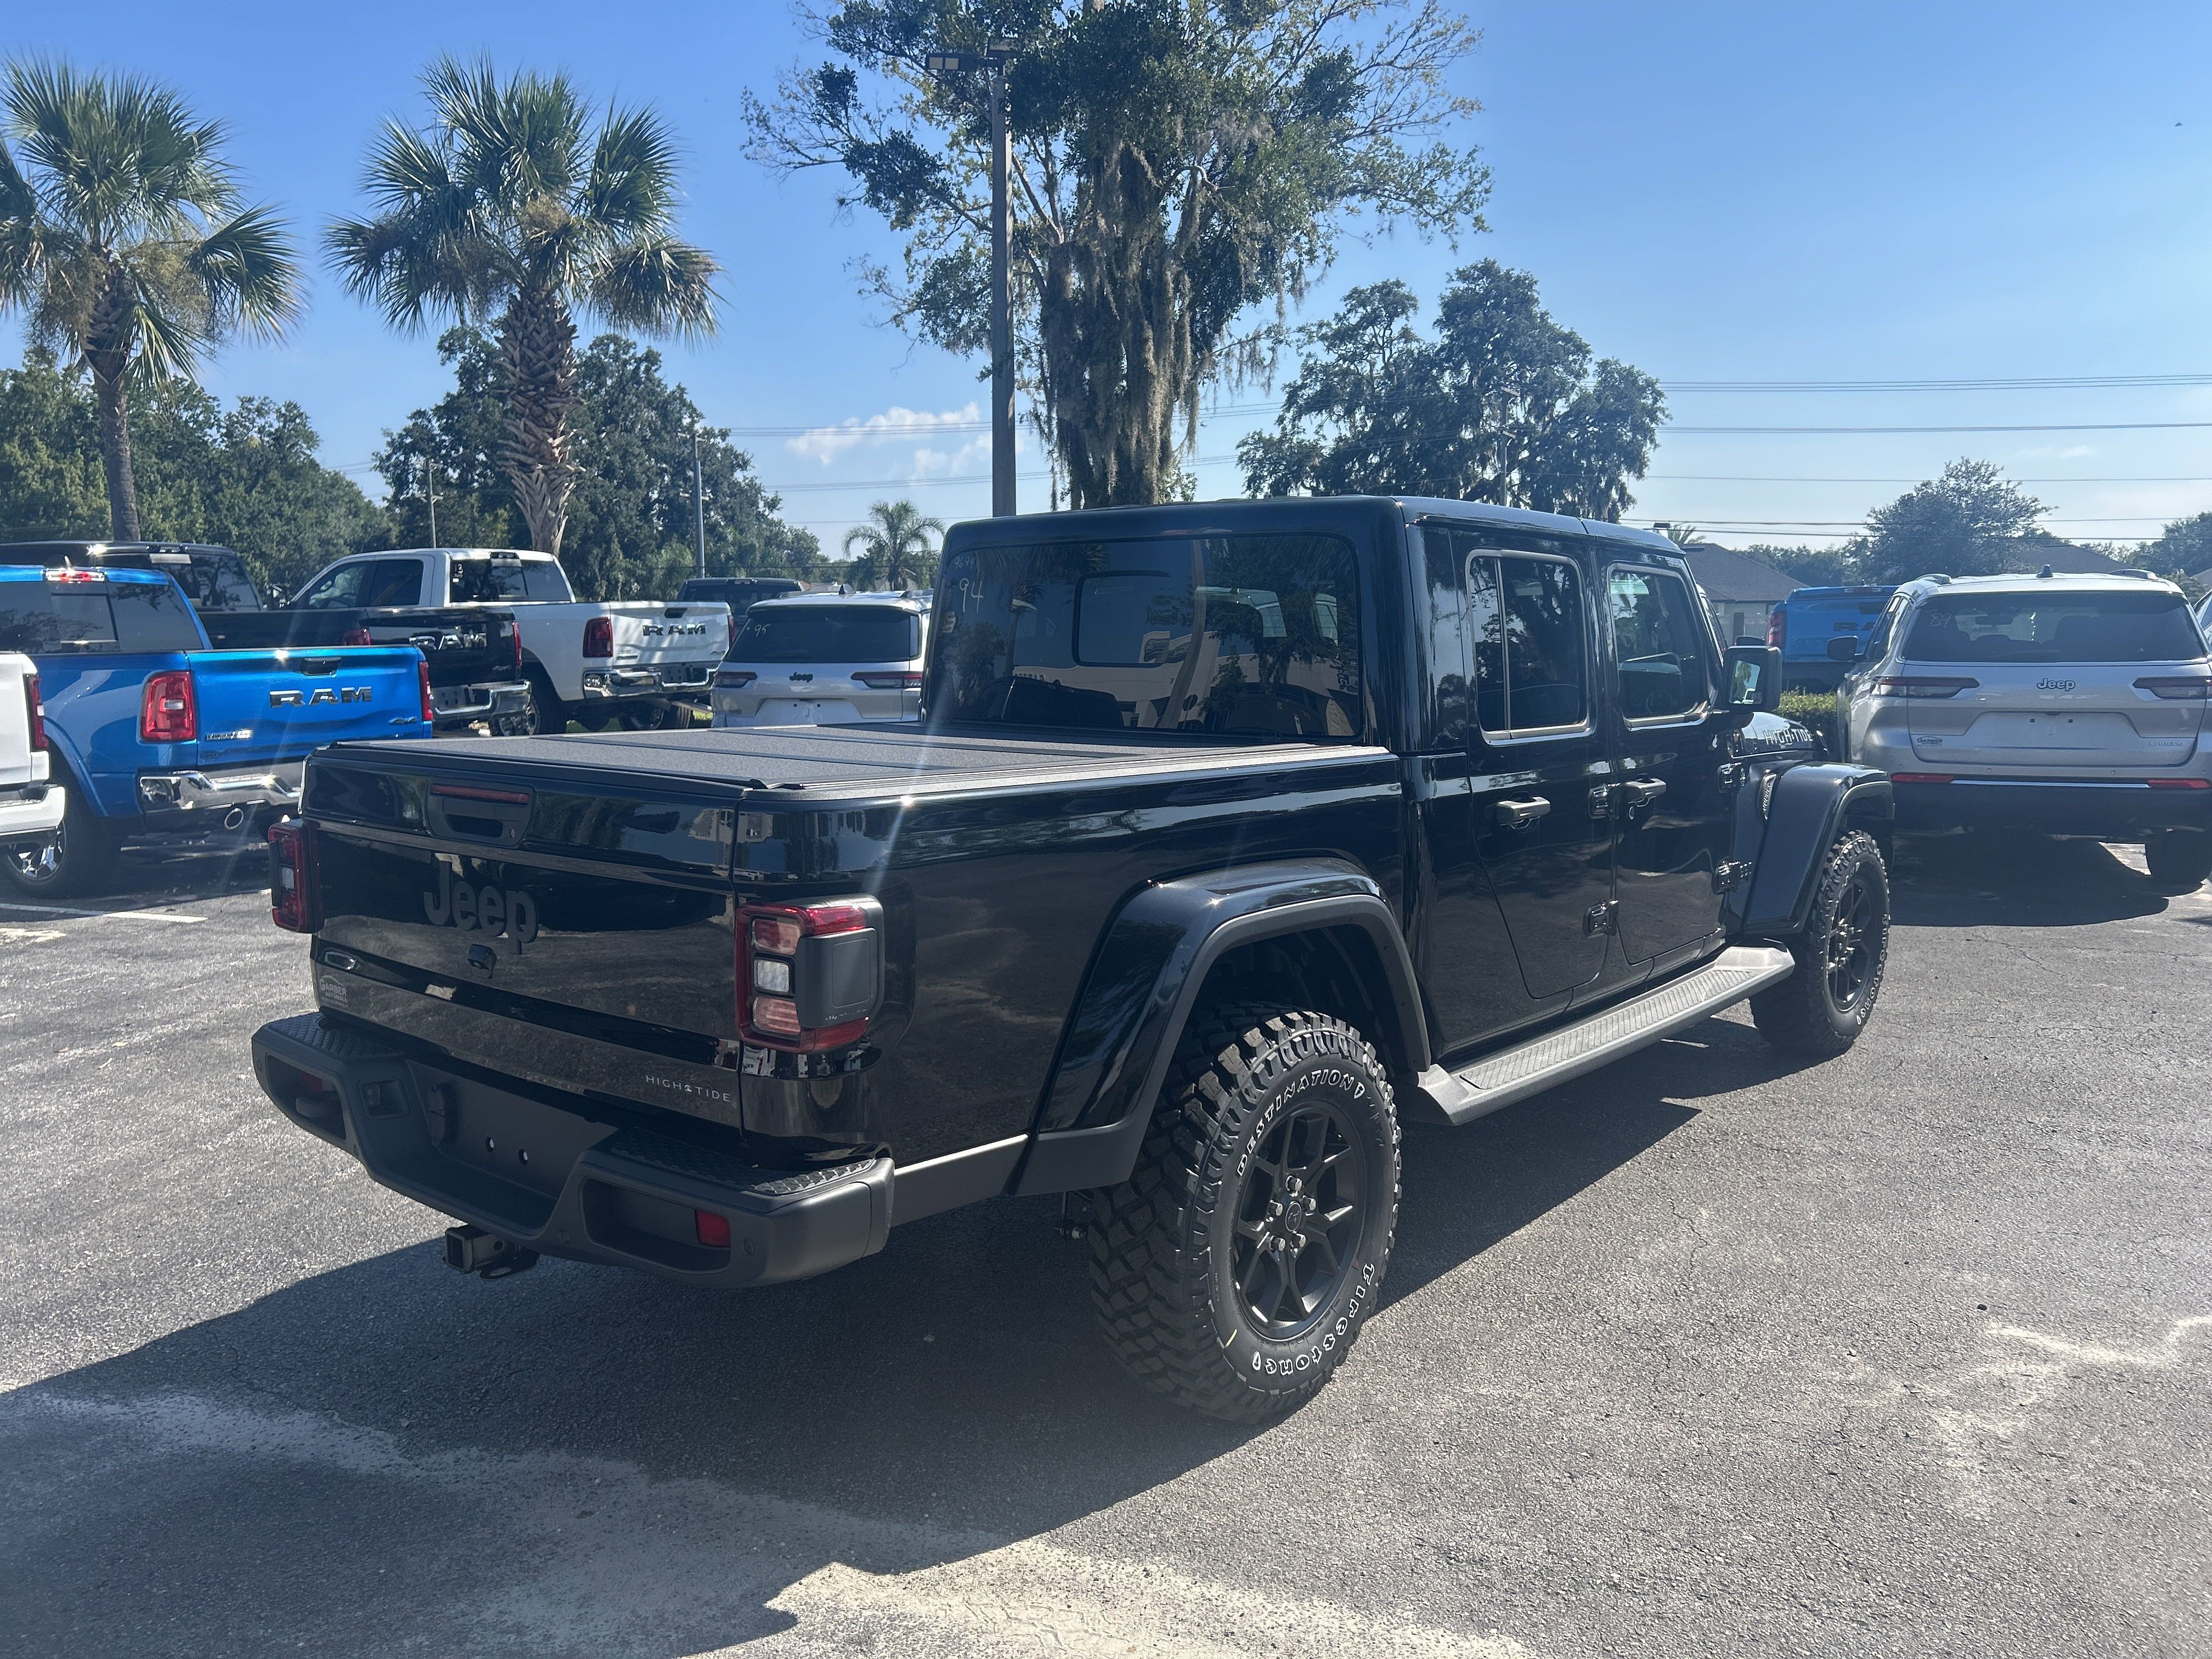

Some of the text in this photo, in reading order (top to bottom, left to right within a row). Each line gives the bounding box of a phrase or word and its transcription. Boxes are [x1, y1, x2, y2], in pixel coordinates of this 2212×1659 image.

[959, 577, 984, 614] 94
[1833, 622, 1876, 631] RA
[1930, 612, 1951, 628] 89
[642, 623, 707, 636] RAM
[409, 633, 487, 651] RAM
[2036, 678, 2076, 692] Jeep
[269, 686, 372, 708] RAM
[423, 860, 538, 955] Jeep
[319, 979, 347, 996] GARBER
[646, 1075, 731, 1102] HIGH TIDE
[1237, 1069, 1355, 1176] DESTINATION
